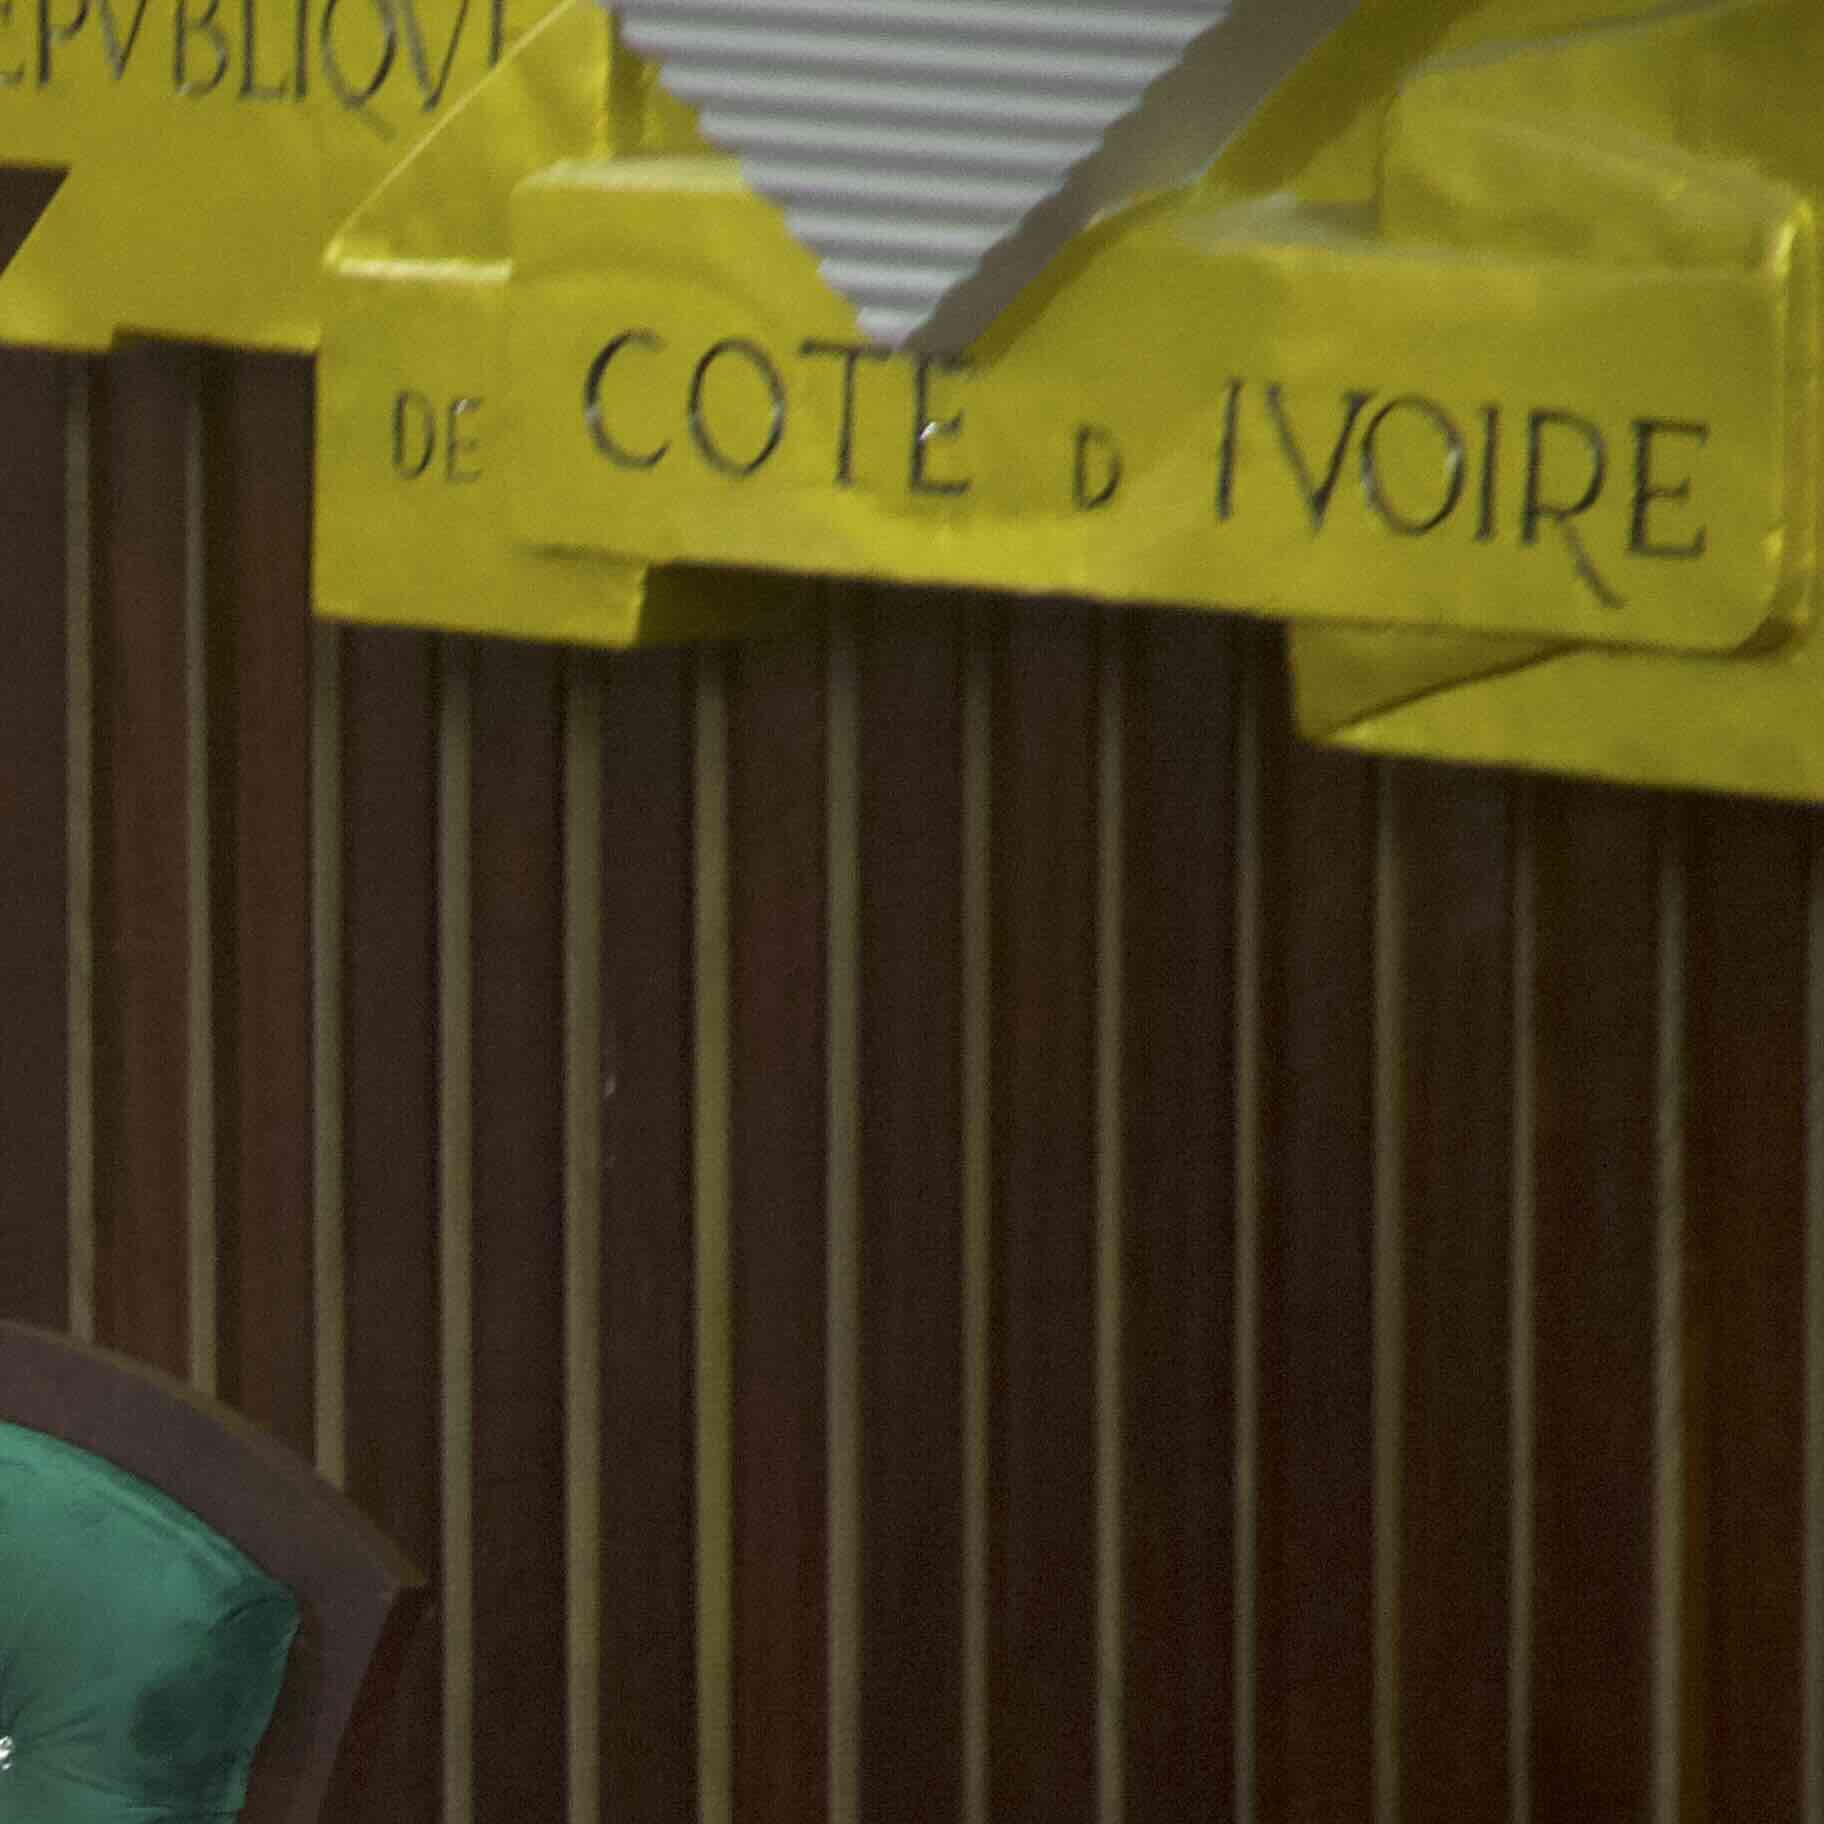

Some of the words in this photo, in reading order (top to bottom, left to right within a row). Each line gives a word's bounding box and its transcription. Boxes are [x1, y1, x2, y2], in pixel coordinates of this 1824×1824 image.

[391, 387, 484, 485] DE
[583, 327, 975, 496] COTE
[1216, 376, 1710, 609] IVOIRE
